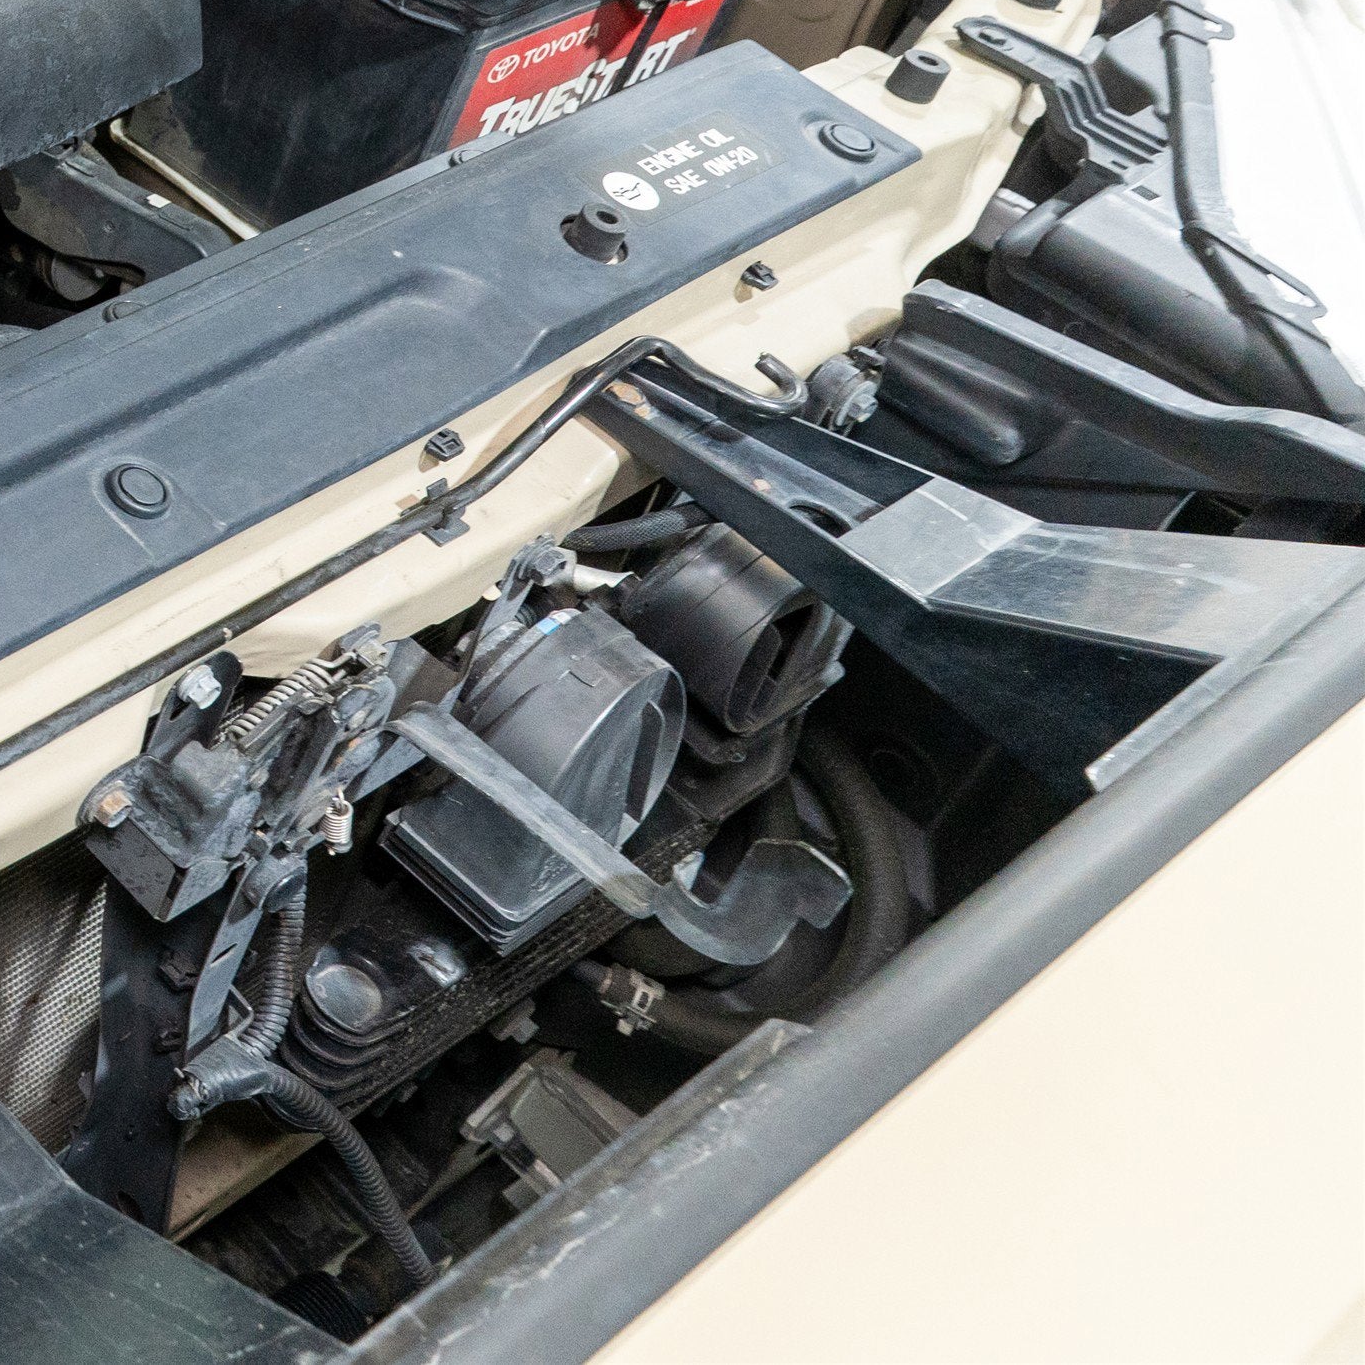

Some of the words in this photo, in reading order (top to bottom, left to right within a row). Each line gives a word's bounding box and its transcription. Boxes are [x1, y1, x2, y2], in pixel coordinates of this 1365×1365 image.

[521, 22, 600, 69] TOYOTA
[478, 28, 691, 138] TRUESTRT
[636, 140, 705, 176] ENGINE
[663, 169, 708, 196] SAE
[703, 145, 760, 178] 0W-20
